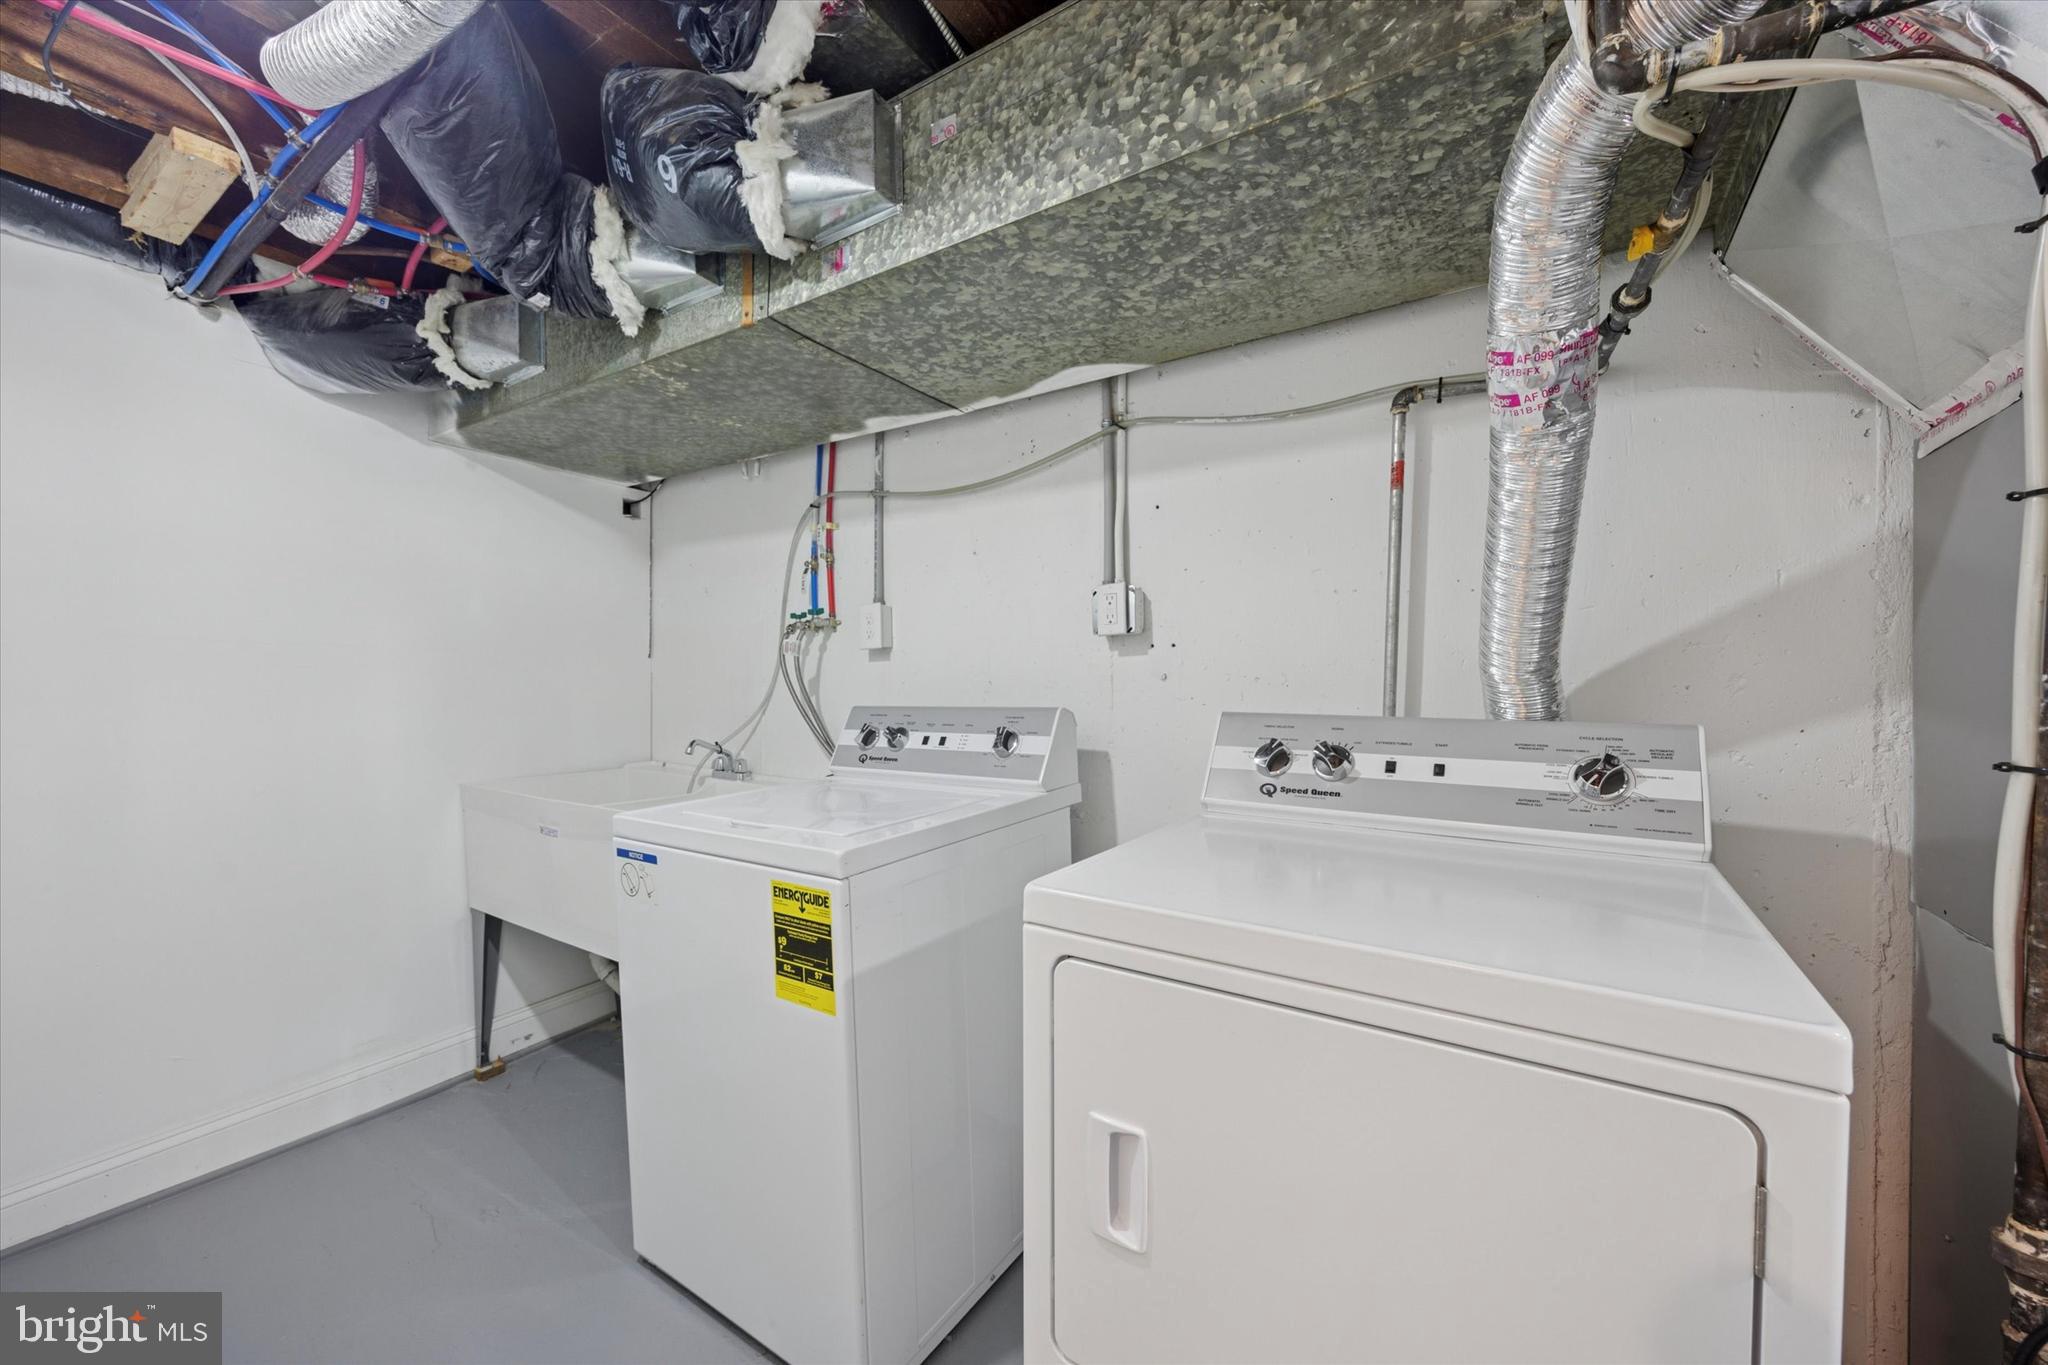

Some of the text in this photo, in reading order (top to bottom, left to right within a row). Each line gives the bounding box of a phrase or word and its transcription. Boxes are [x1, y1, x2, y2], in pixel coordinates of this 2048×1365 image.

[1517, 353, 1531, 364] AF
[1534, 350, 1555, 362] 099
[1523, 392, 1539, 404] AF
[1542, 384, 1561, 399] 099
[1280, 786, 1309, 796] Speed
[1310, 788, 1341, 798] Queen
[773, 886, 830, 909] ENERGYGUIDE
